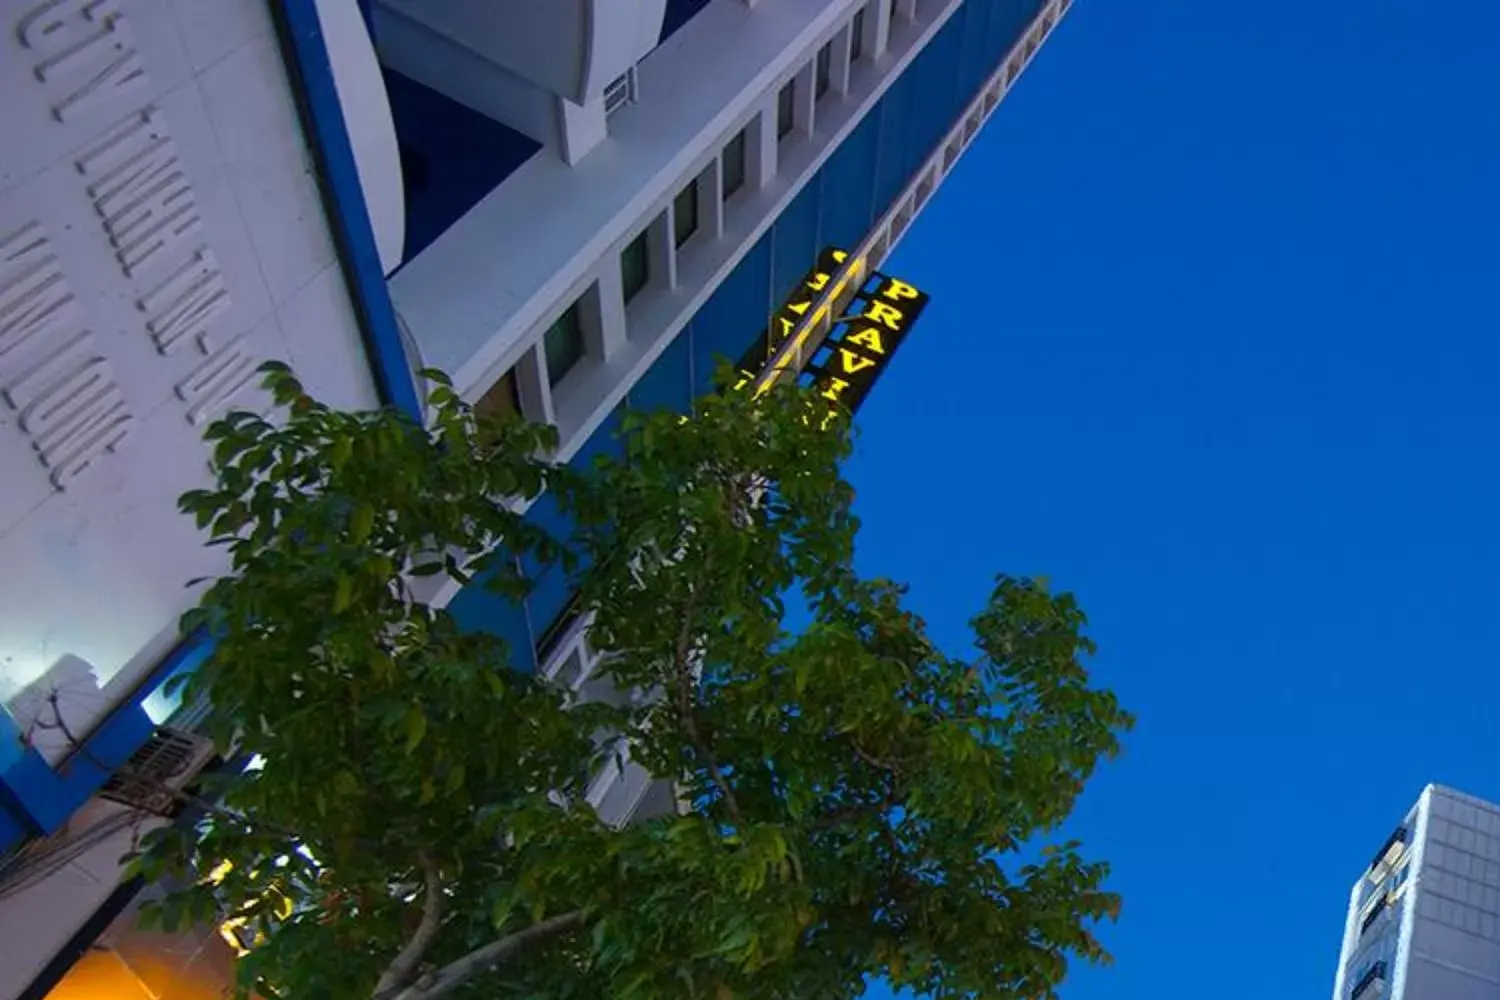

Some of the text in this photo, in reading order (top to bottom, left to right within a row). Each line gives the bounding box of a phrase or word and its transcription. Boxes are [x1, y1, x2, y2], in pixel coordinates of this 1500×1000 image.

[15, 0, 147, 124] CTY
[73, 102, 203, 279] TNHH
[1, 328, 135, 493] LONG
[798, 277, 920, 432] PRAVI
